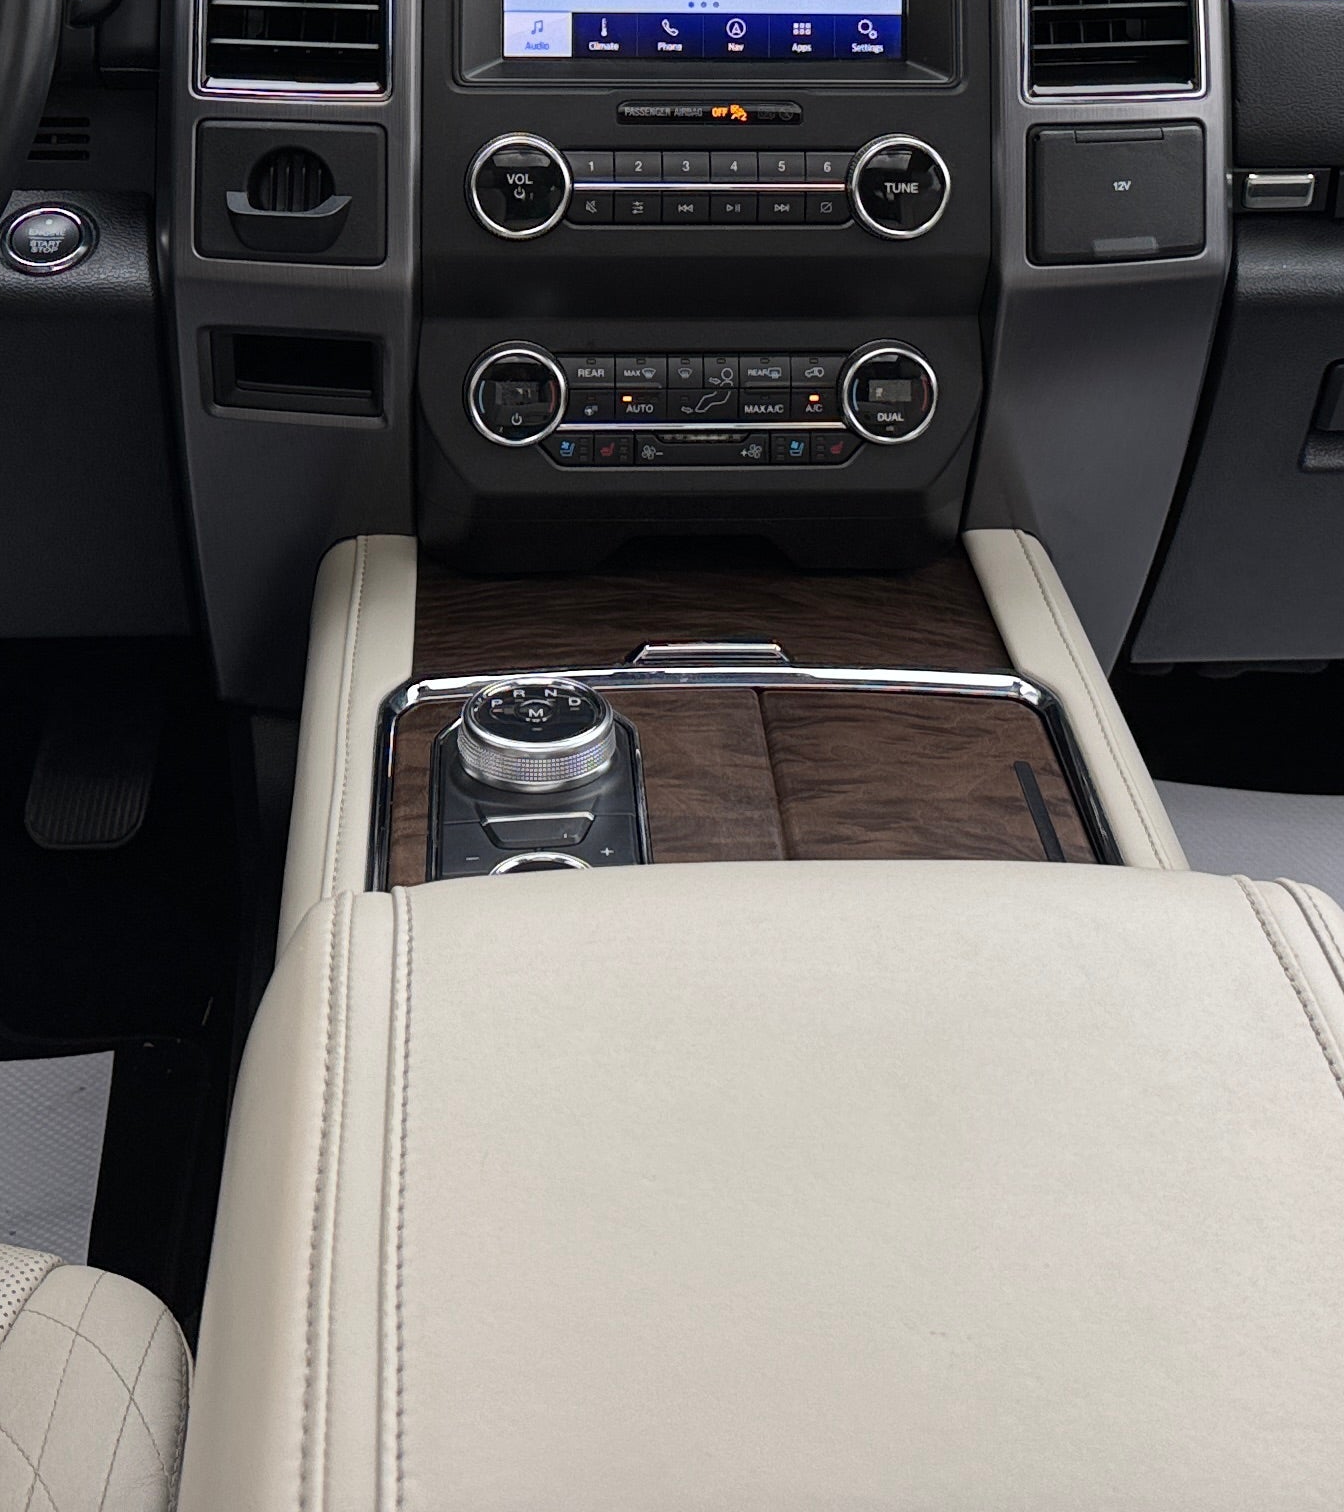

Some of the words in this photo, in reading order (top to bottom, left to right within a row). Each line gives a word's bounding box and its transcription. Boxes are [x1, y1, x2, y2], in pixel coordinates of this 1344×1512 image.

[525, 41, 550, 51] Audio
[588, 41, 619, 51] Climate
[658, 41, 682, 51] Phone
[727, 42, 744, 52] Nav
[791, 43, 812, 53] Apps
[851, 43, 884, 54] Settings
[624, 107, 671, 117] PASSENGER
[711, 107, 728, 117] OFF
[588, 161, 594, 172] 1
[635, 161, 643, 172] 2
[682, 161, 690, 172] 3
[730, 161, 738, 172] 4
[778, 161, 786, 172] 5
[823, 161, 831, 172] 6
[506, 173, 533, 185] VOL
[884, 182, 919, 194] TUNE
[1113, 180, 1131, 191] 12V
[31, 246, 58, 254] STOP
[577, 369, 605, 378] REAR
[626, 404, 654, 413] AUTO
[744, 405, 765, 414] MAX
[767, 404, 784, 413] A/C
[806, 404, 823, 413] A/C
[877, 412, 904, 422] DUAL
[513, 689, 525, 698] R
[545, 689, 557, 697] N
[491, 699, 503, 708] P
[569, 696, 581, 706] D
[528, 708, 544, 718] M
